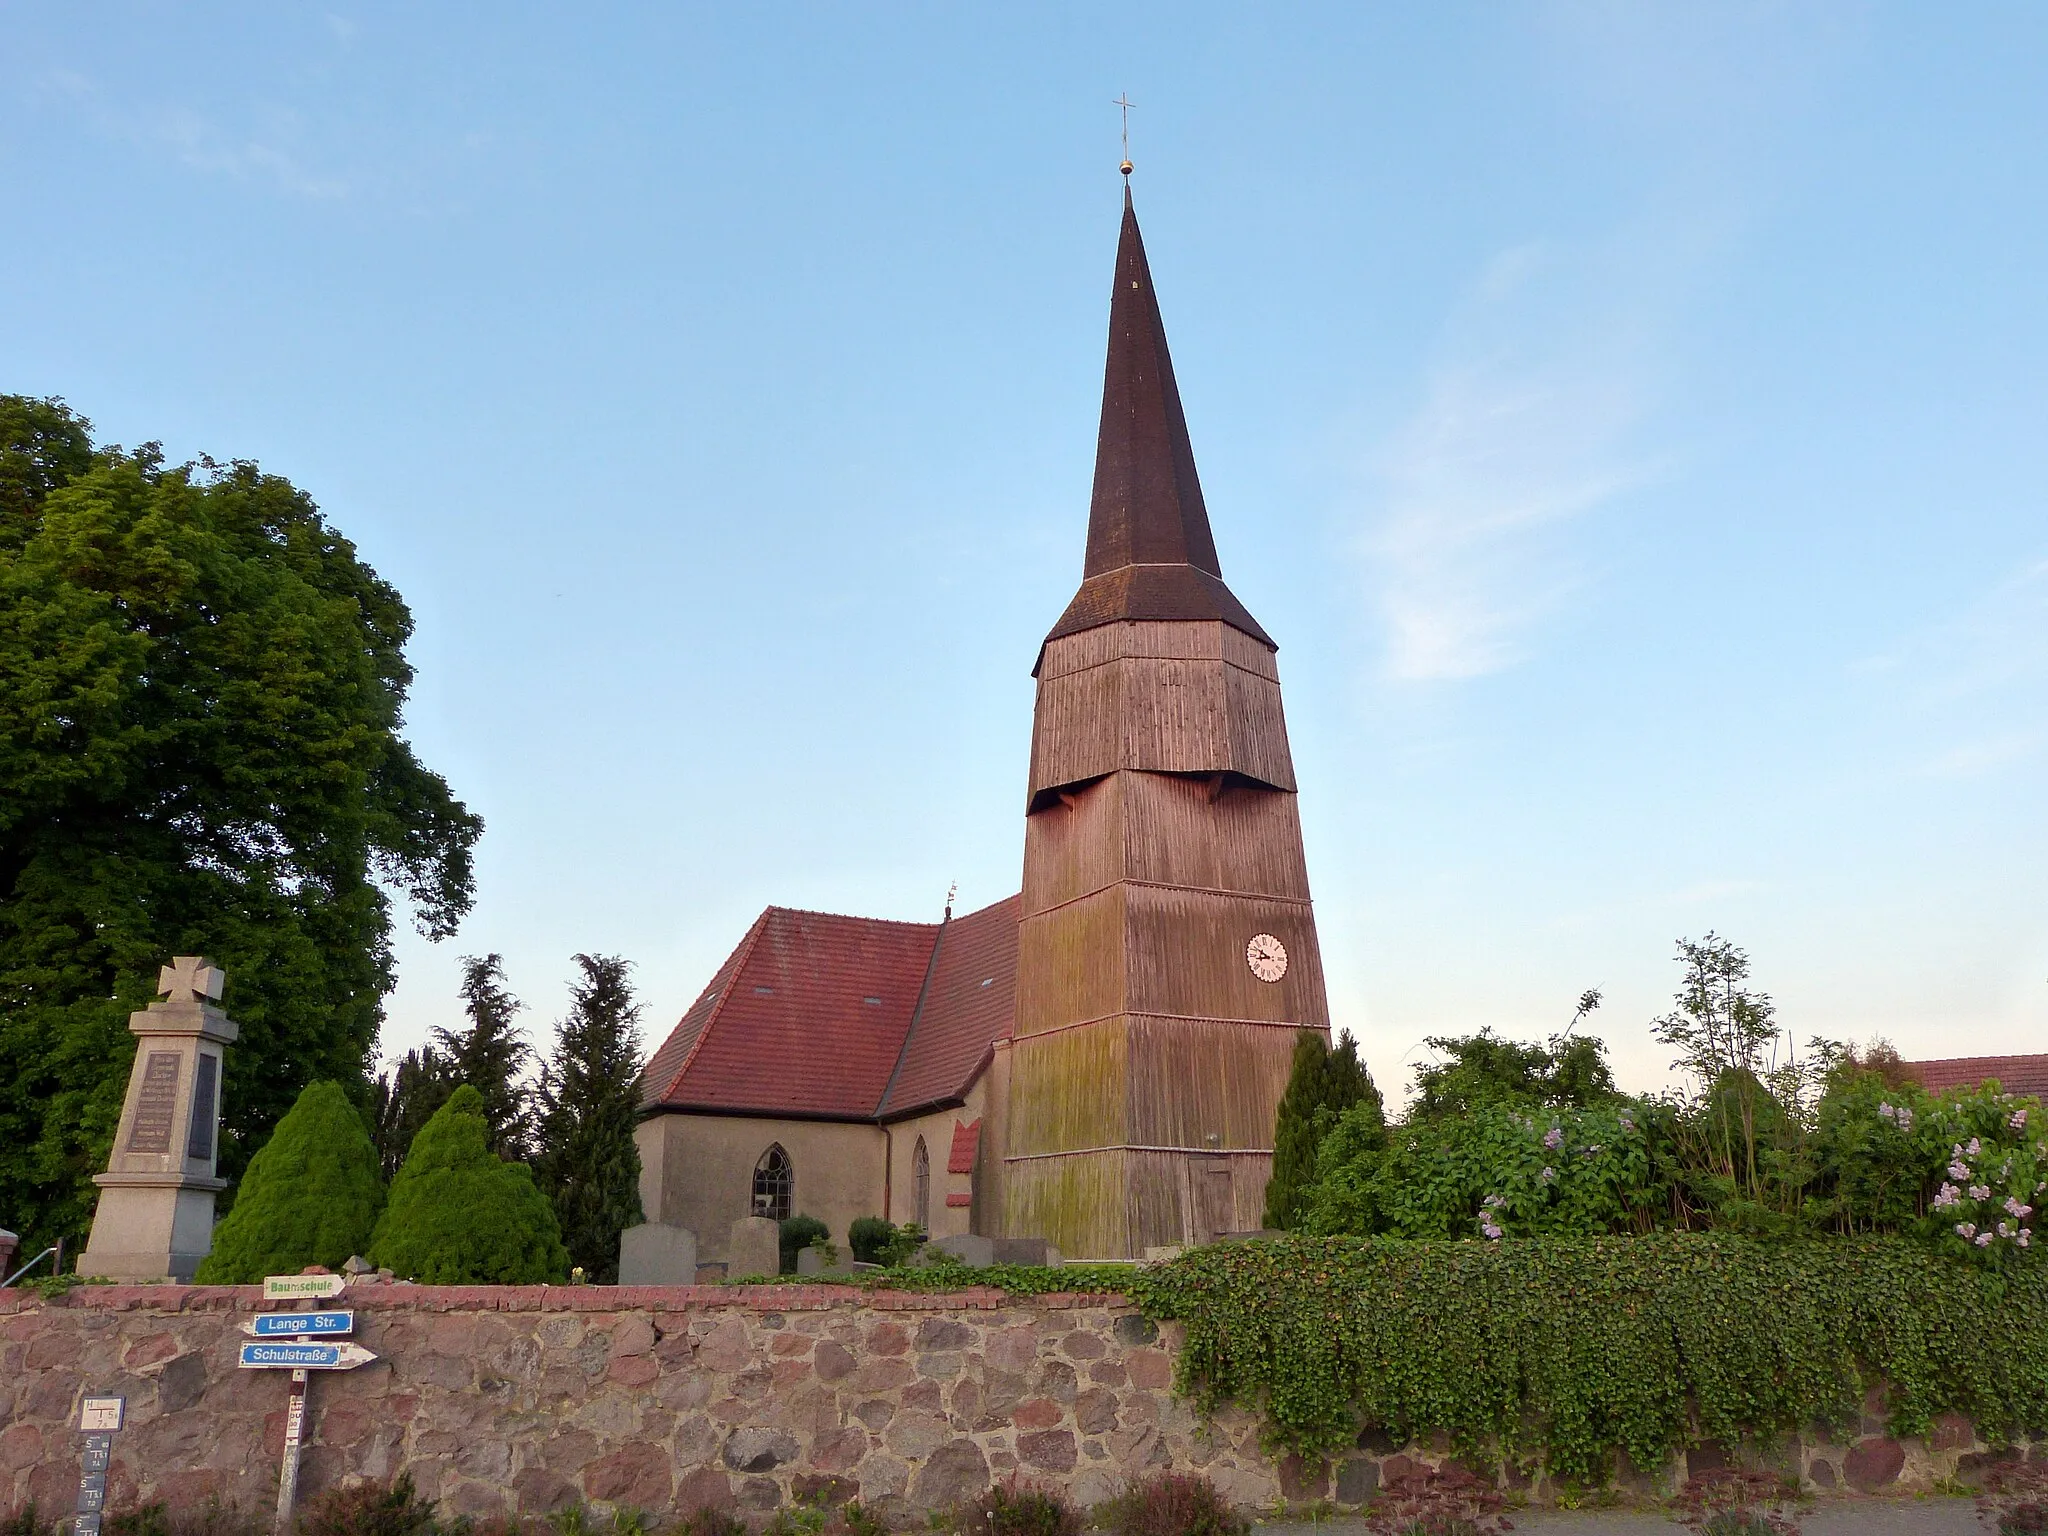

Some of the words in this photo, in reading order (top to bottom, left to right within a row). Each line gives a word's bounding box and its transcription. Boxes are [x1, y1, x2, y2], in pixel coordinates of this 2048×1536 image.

[271, 1280, 333, 1293] Baumschule
[268, 1317, 307, 1331] Lange
[315, 1316, 336, 1328] Str.
[253, 1348, 328, 1361] Schulstraße
[87, 1400, 93, 1408] H
[86, 1439, 92, 1448] S
[80, 1479, 87, 1488] S
[76, 1519, 82, 1528] S
